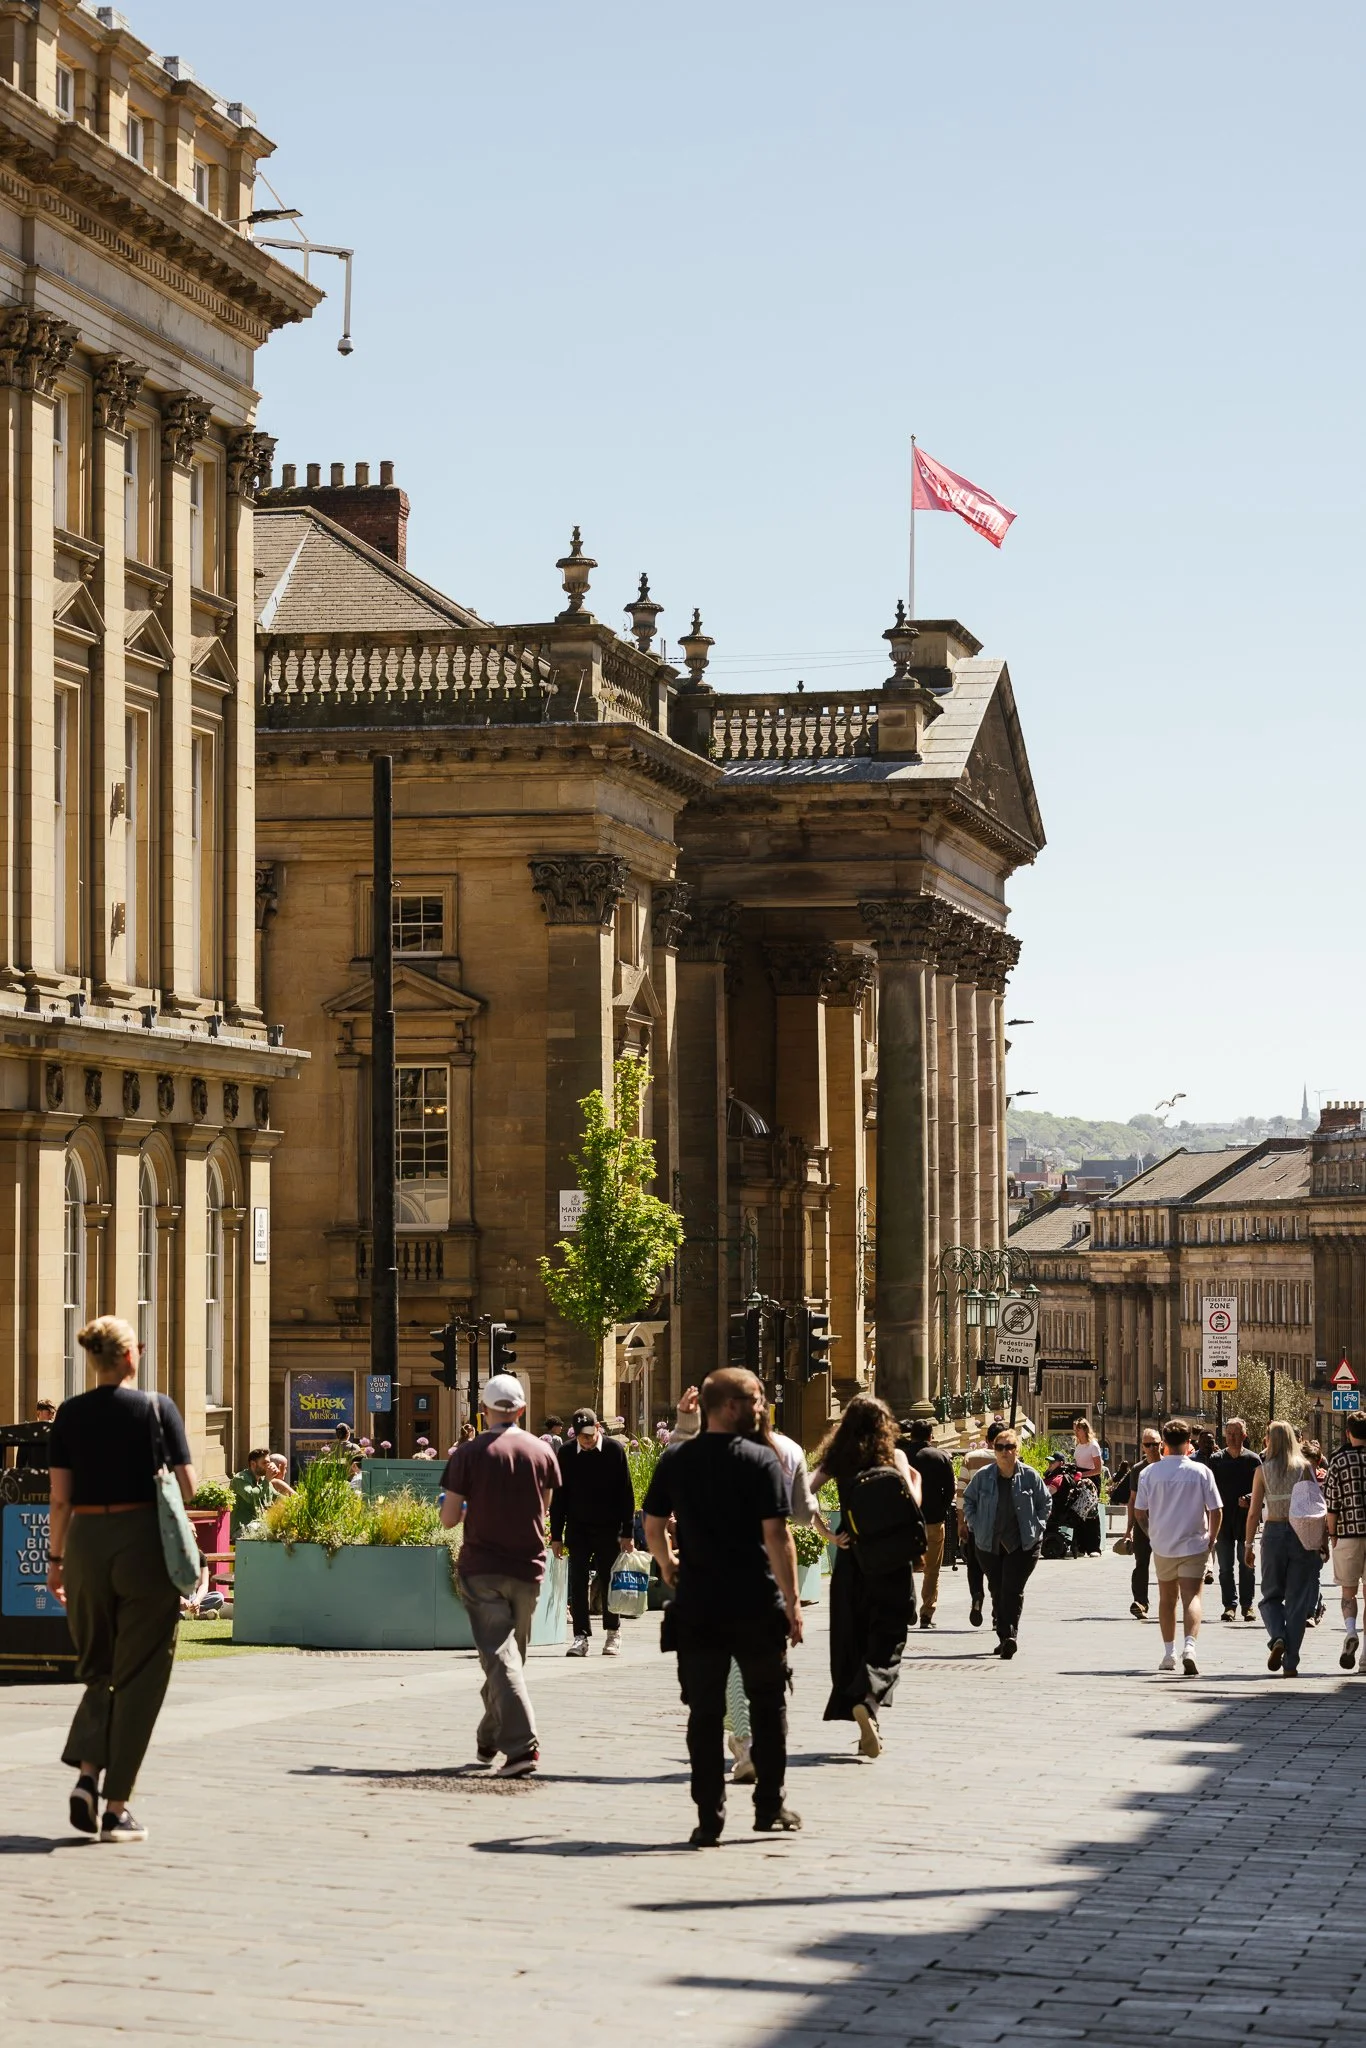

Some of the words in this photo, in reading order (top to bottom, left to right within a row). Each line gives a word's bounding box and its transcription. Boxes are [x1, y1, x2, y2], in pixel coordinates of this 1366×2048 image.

[998, 1339, 1034, 1348] Pedestrian
[999, 1354, 1029, 1365] ENDS
[22, 1493, 50, 1502] LITTE
[21, 1513, 51, 1525] TIM
[17, 1550, 50, 1561] YOU
